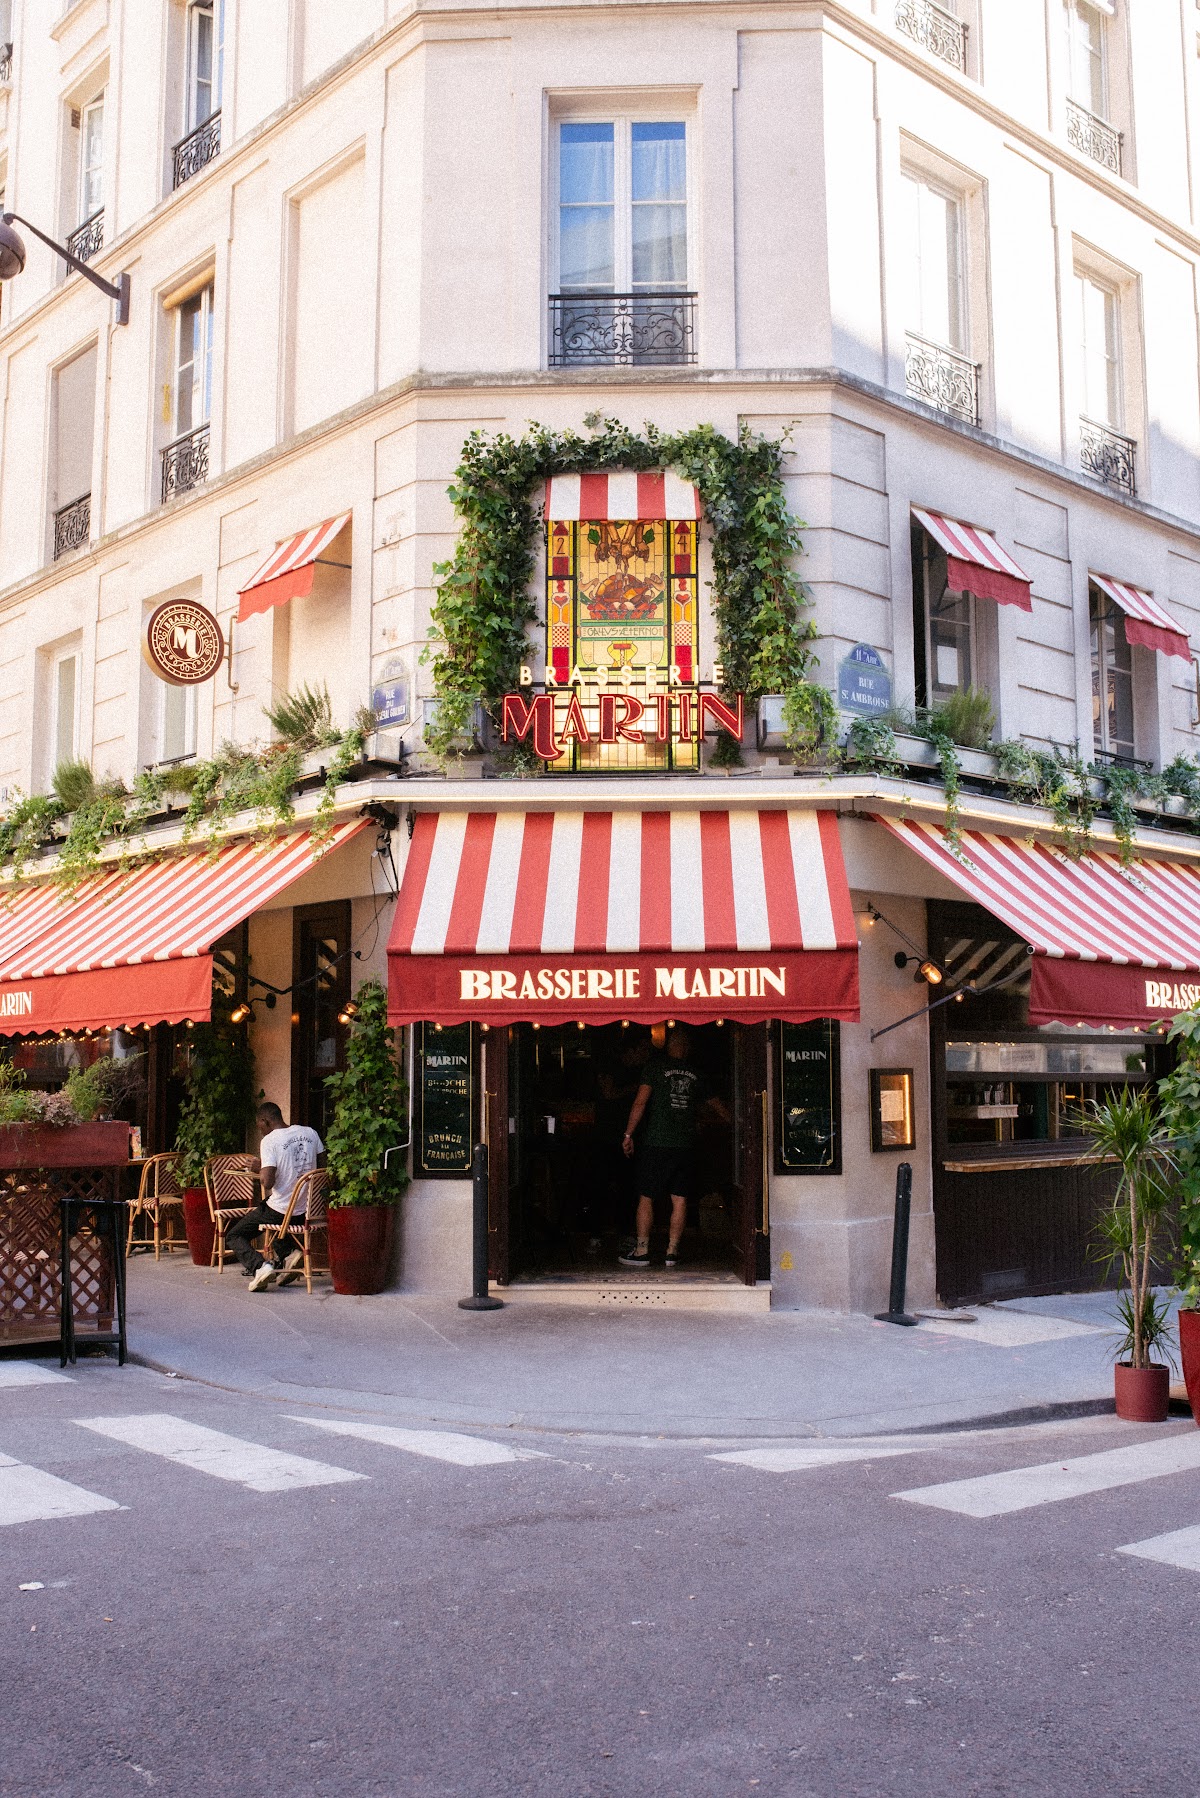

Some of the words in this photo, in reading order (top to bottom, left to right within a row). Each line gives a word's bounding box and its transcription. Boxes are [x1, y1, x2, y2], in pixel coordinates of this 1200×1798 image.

[677, 535, 688, 552] 4
[164, 614, 207, 637] BRASSERIE
[520, 664, 724, 686] BRASSERIE
[858, 677, 874, 689] RUE
[502, 693, 744, 760] MARTIN
[459, 968, 640, 1000] BRASSERIE
[655, 967, 787, 1000] MARTIN
[0, 991, 32, 1016] ARTIN
[426, 1055, 468, 1067] MARTIN
[785, 1050, 827, 1063] MARTIN
[428, 1133, 462, 1144] BRUNCH
